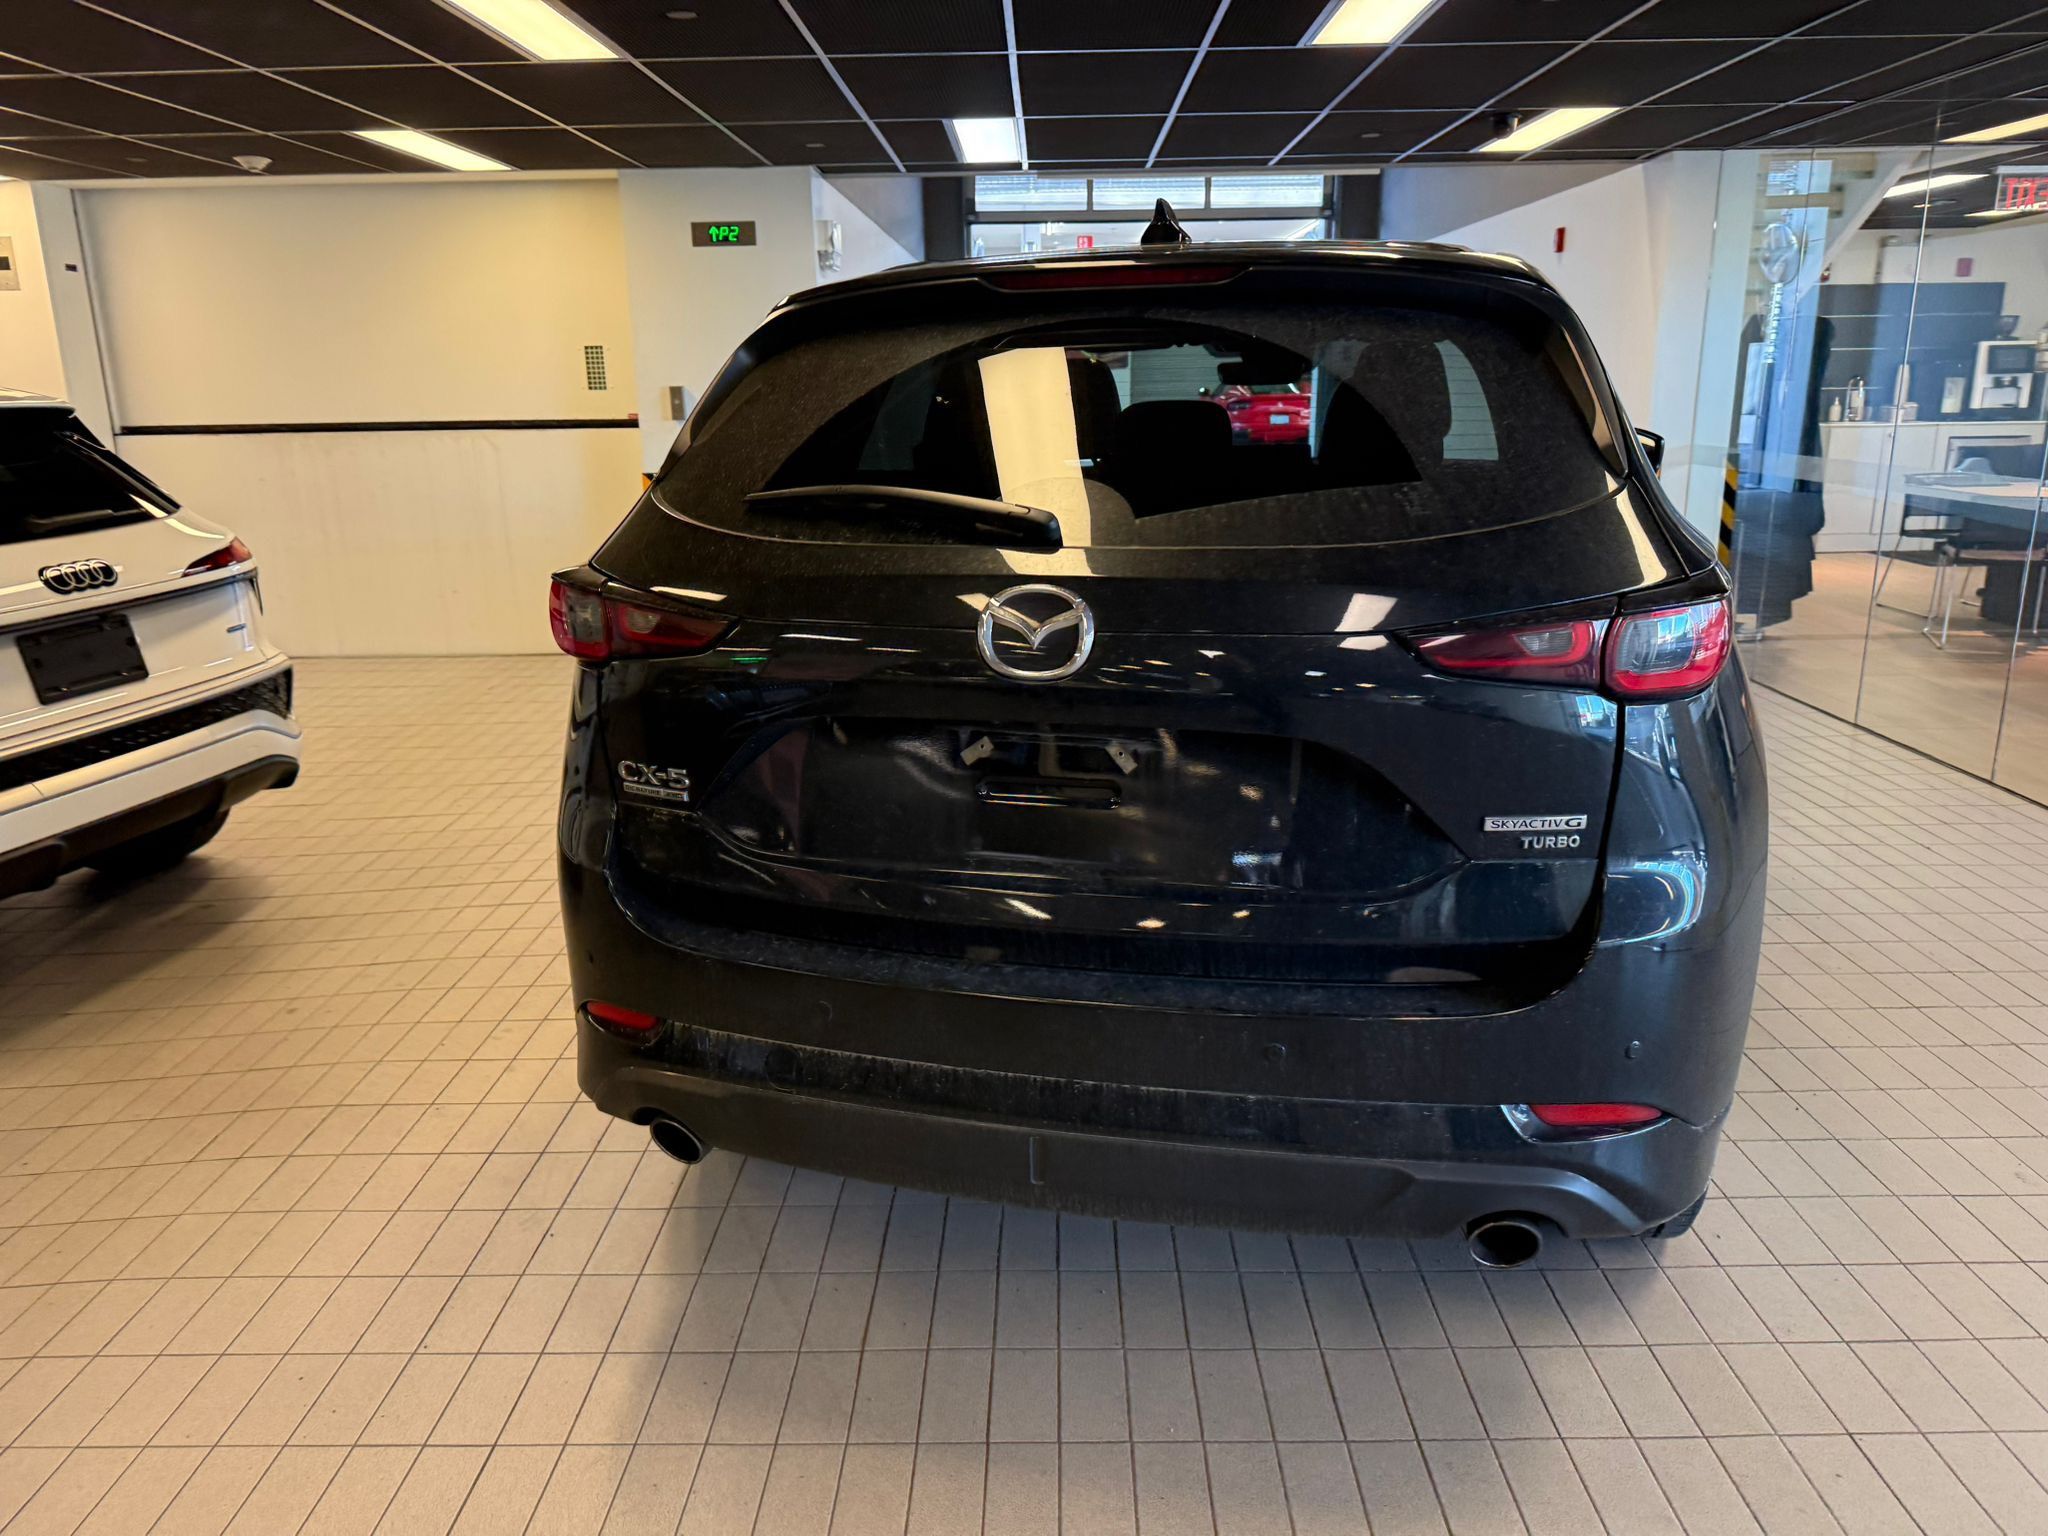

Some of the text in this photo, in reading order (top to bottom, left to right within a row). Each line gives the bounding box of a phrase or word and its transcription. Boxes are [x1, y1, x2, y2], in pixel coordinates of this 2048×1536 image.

[719, 226, 740, 241] P2
[617, 760, 690, 789] CX-5
[1521, 835, 1581, 849] TURBO
